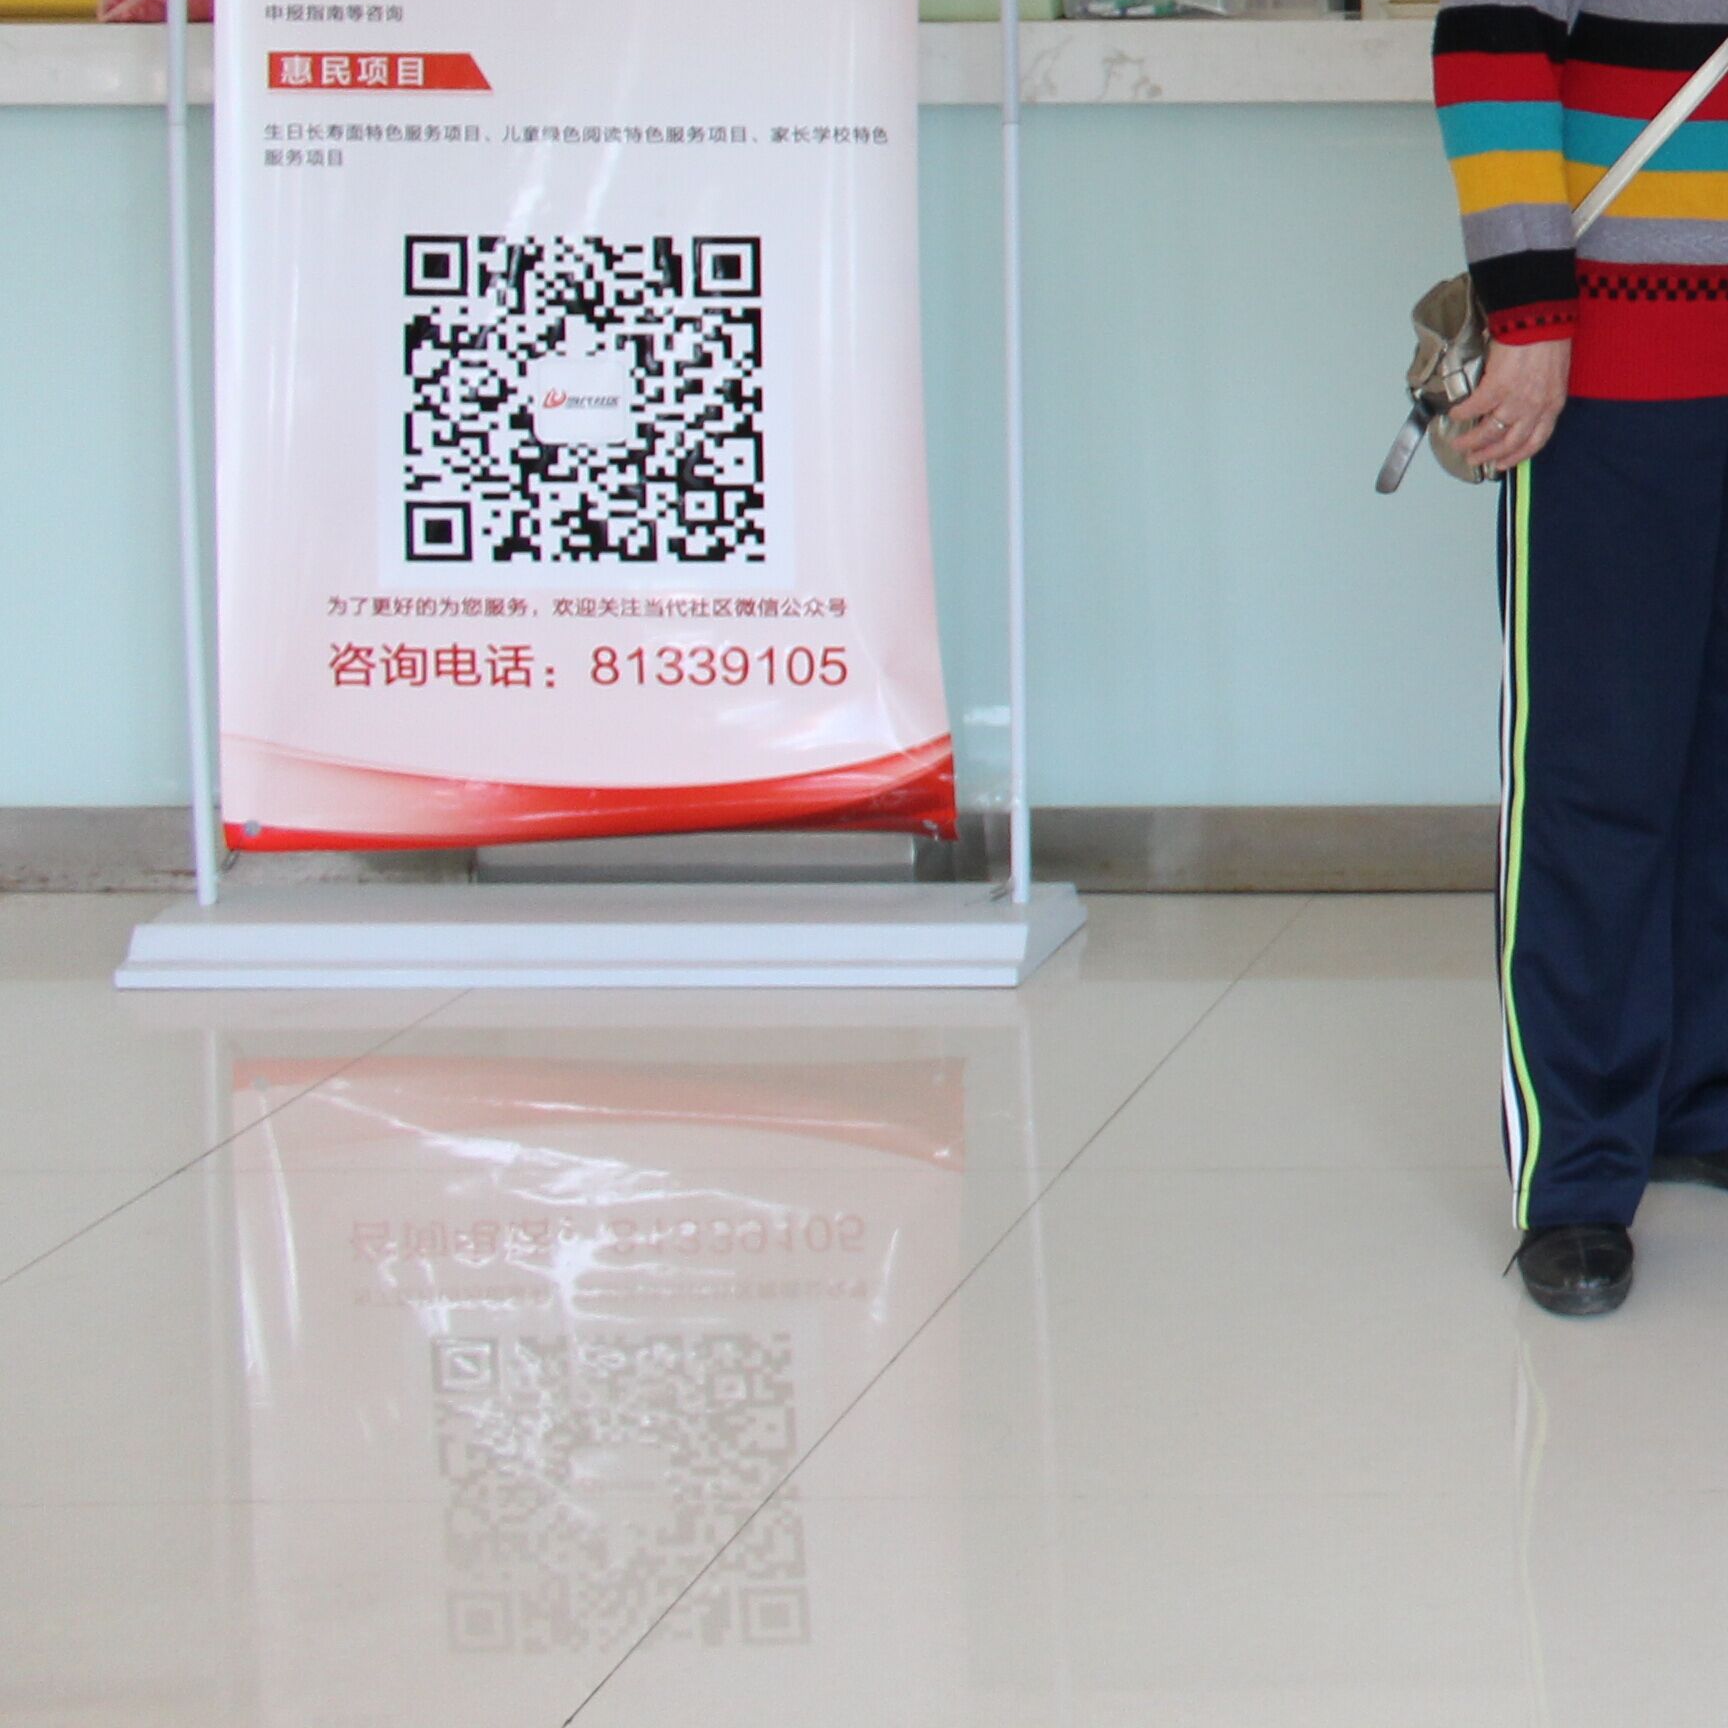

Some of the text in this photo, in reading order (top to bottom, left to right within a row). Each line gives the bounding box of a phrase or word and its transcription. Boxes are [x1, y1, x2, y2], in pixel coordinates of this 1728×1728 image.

[280, 56, 426, 87] 惠民项目
[264, 148, 343, 167] 服务项目
[327, 596, 847, 619] 为了更好的为您服务，欢迎关注当代社区微信公众号
